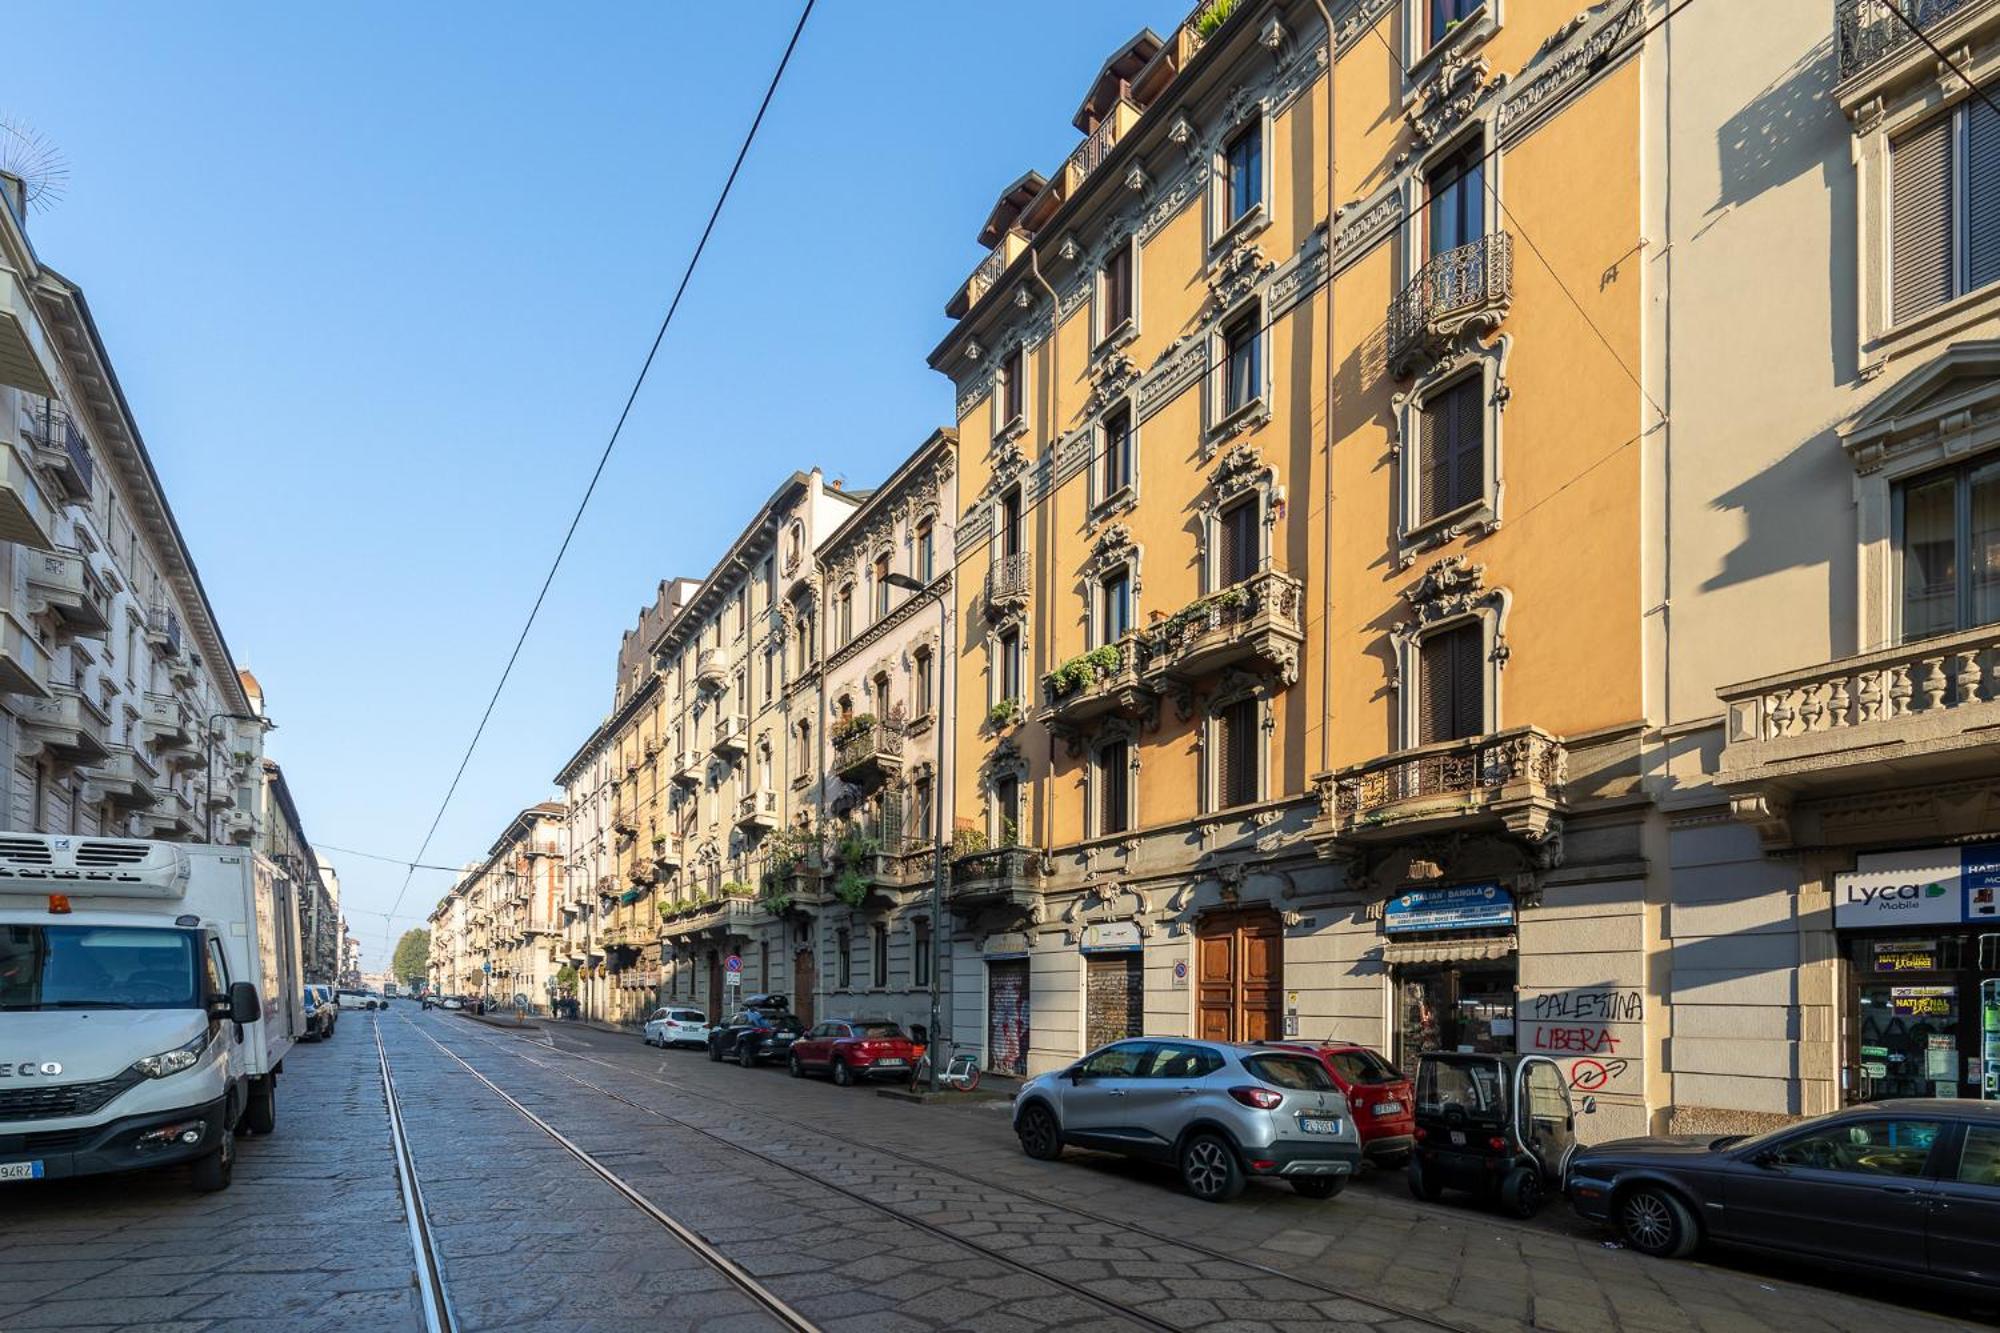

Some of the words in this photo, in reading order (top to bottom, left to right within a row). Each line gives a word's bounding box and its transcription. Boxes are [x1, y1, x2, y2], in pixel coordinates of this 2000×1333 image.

[1411, 892, 1443, 902] ITALIAN
[1848, 884, 1919, 905] Lyca
[1879, 901, 1919, 910] Mobile
[1535, 991, 1643, 1020] PALESTINA
[1535, 1027, 1620, 1053] LIBERA
